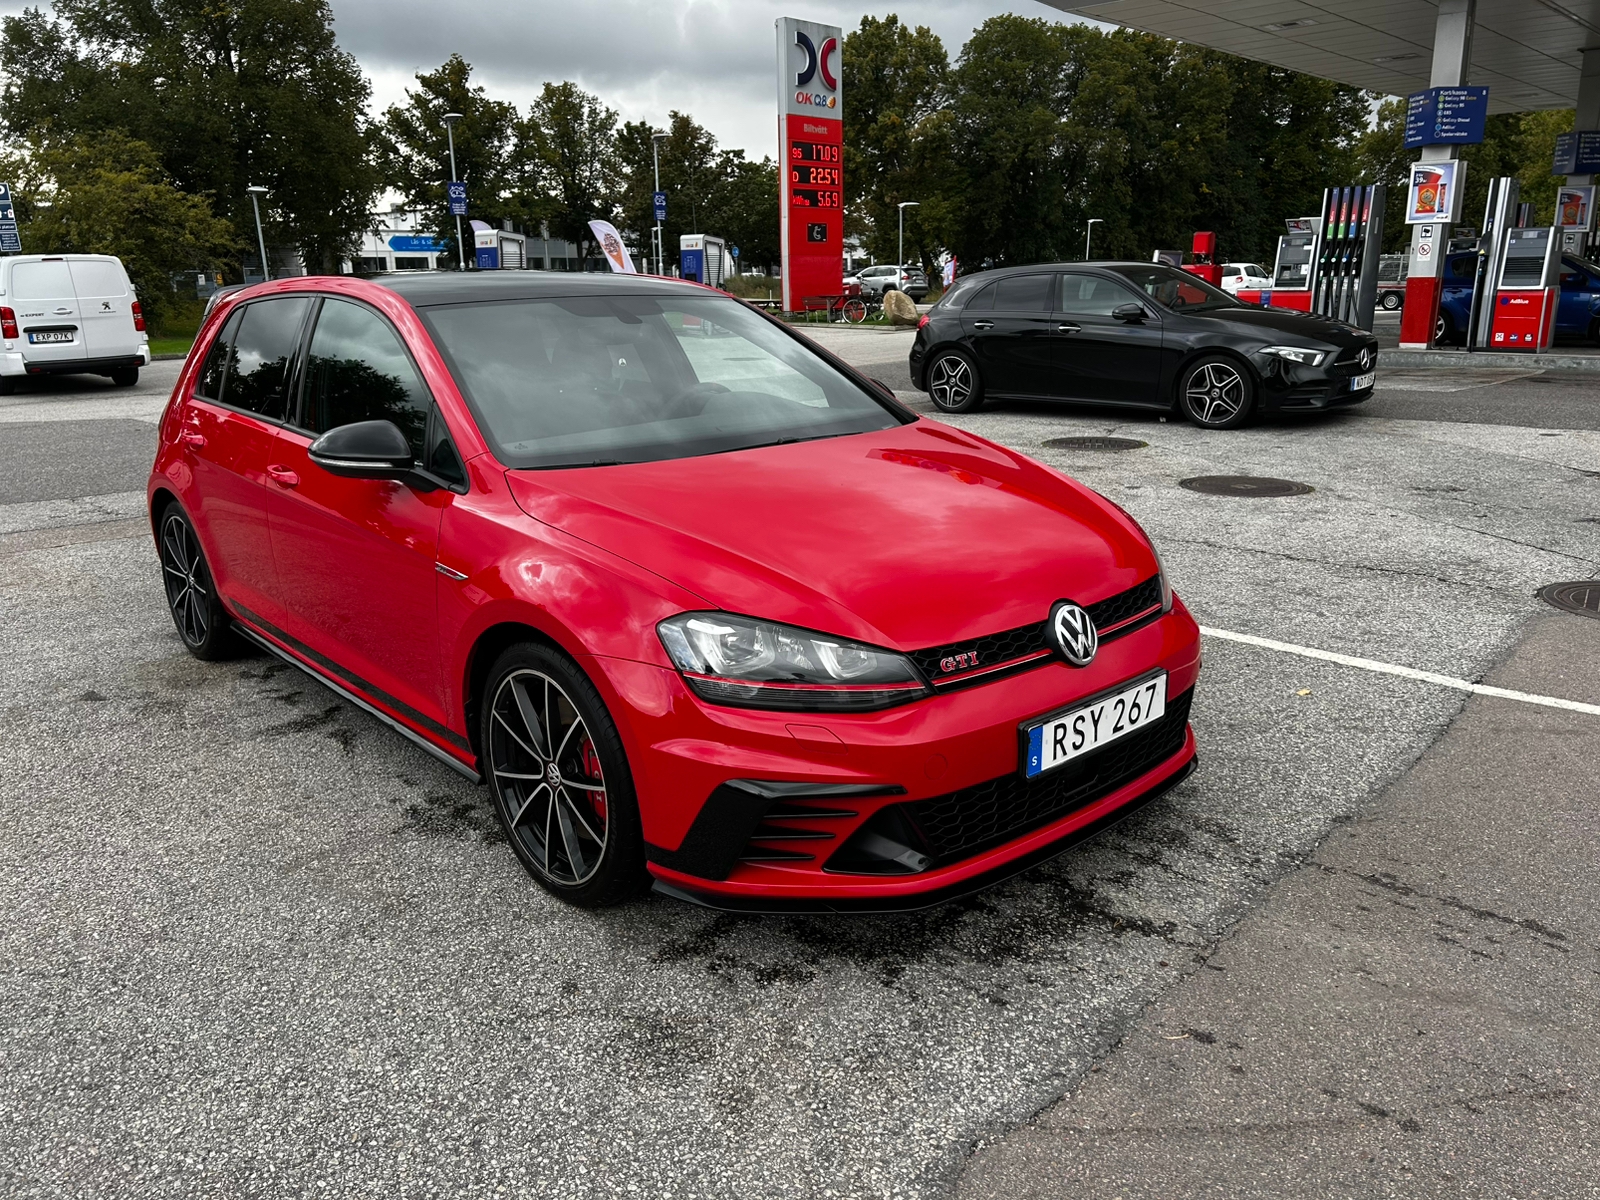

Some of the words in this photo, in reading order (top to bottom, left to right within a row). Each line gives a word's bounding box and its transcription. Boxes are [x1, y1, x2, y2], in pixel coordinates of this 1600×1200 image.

[803, 123, 828, 135] Biltvätt
[792, 147, 802, 159] 95
[792, 171, 799, 182] D
[35, 333, 52, 341] EXP
[53, 332, 70, 341] 07K
[940, 651, 979, 673] GTI
[1052, 705, 1105, 761] RSY
[1112, 682, 1158, 734] 267
[1031, 755, 1038, 767] S
